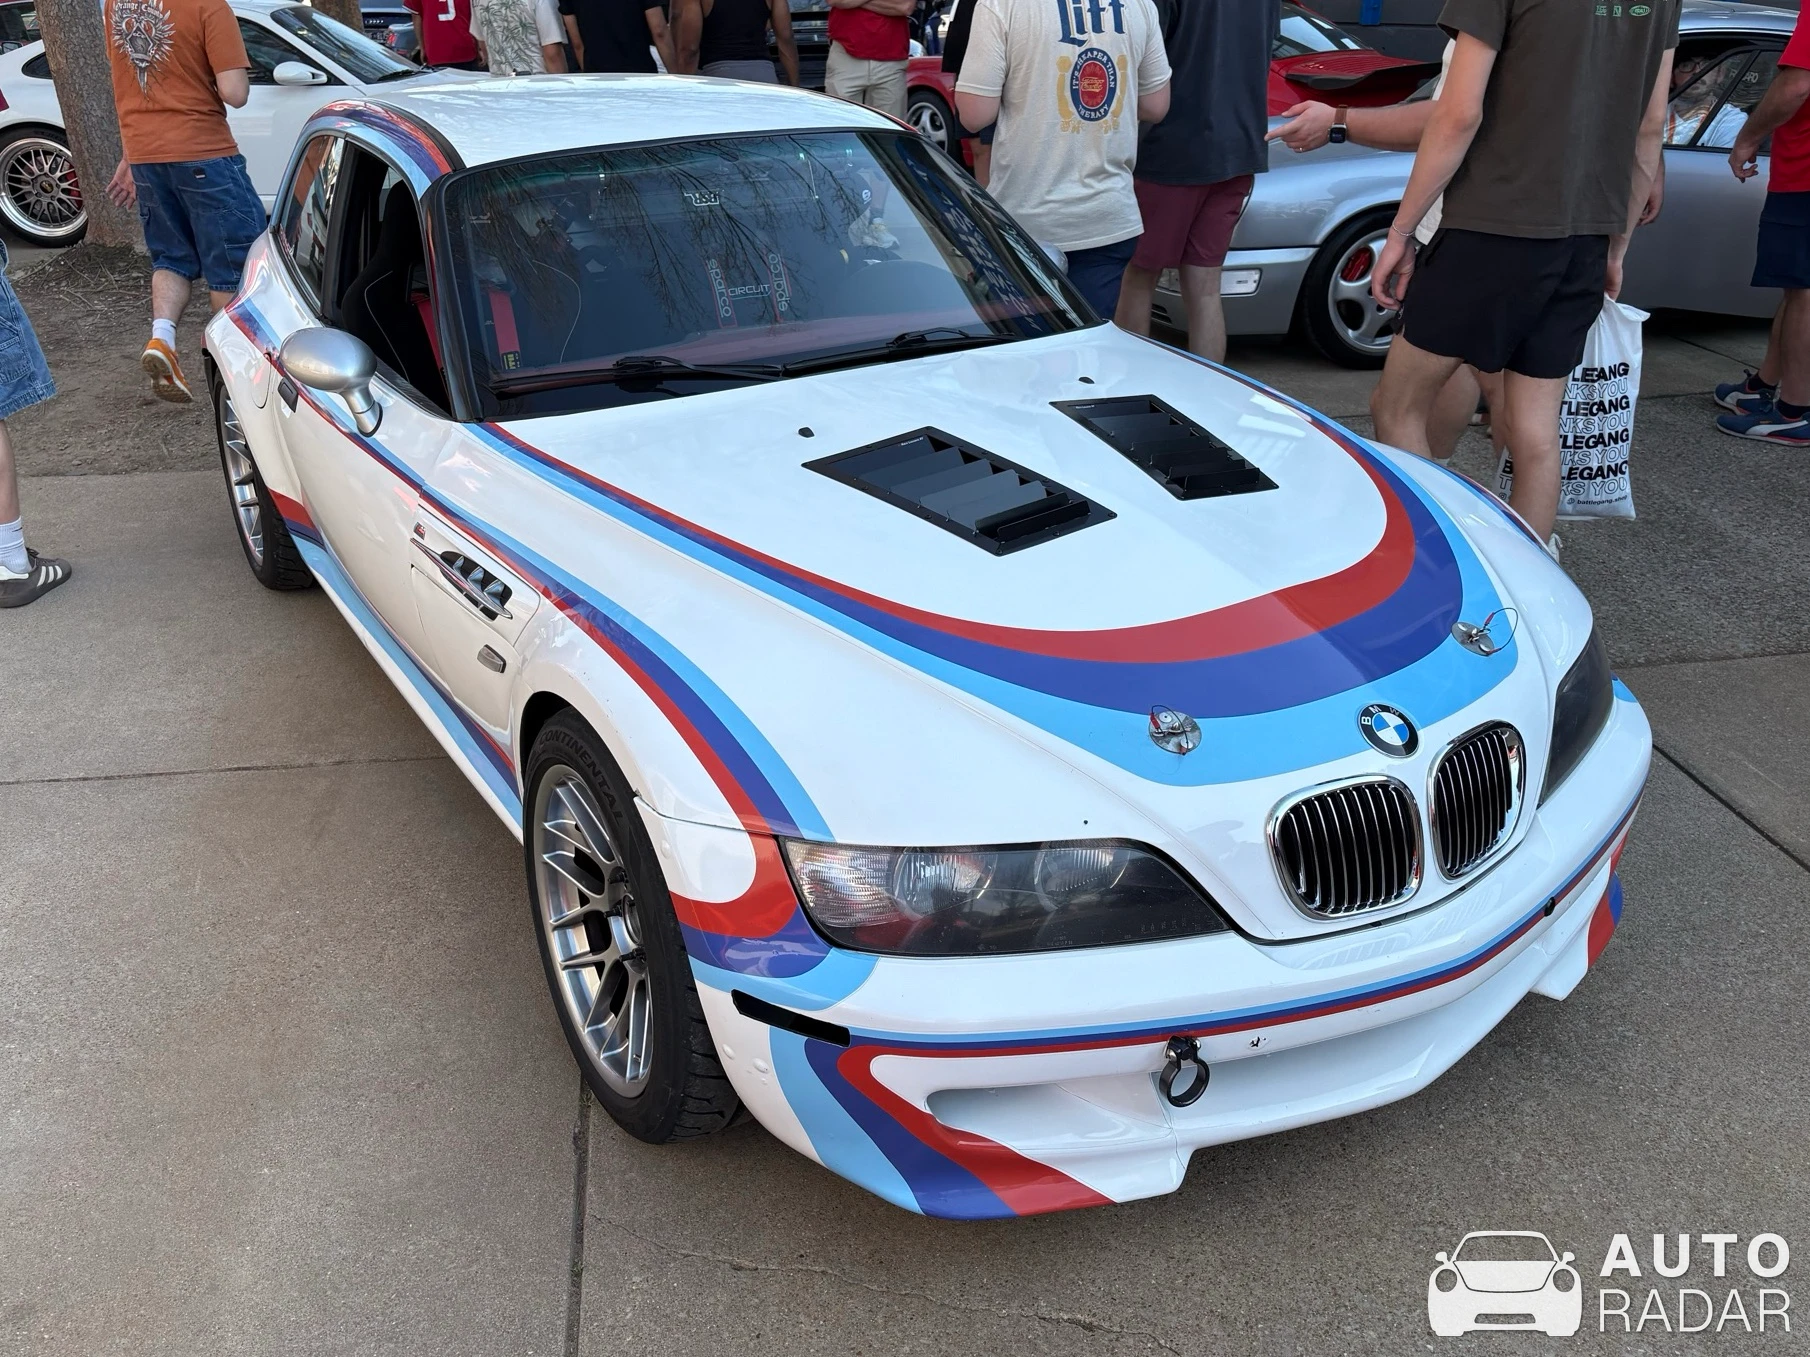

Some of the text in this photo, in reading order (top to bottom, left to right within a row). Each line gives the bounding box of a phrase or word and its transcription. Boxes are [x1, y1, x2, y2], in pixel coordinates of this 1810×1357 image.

[1106, 62, 1116, 87] THAN
[1079, 104, 1109, 119] THERAPY
[707, 258, 732, 317] sparco
[728, 284, 770, 296] CIRCUIT
[768, 253, 791, 312] sparco
[1597, 378, 1629, 399] YOU
[1597, 410, 1631, 432] YOU
[1595, 443, 1630, 464] YOU
[1591, 476, 1628, 497] YOU
[1361, 704, 1400, 726] BMW
[538, 729, 625, 823] CONTINENTAL
